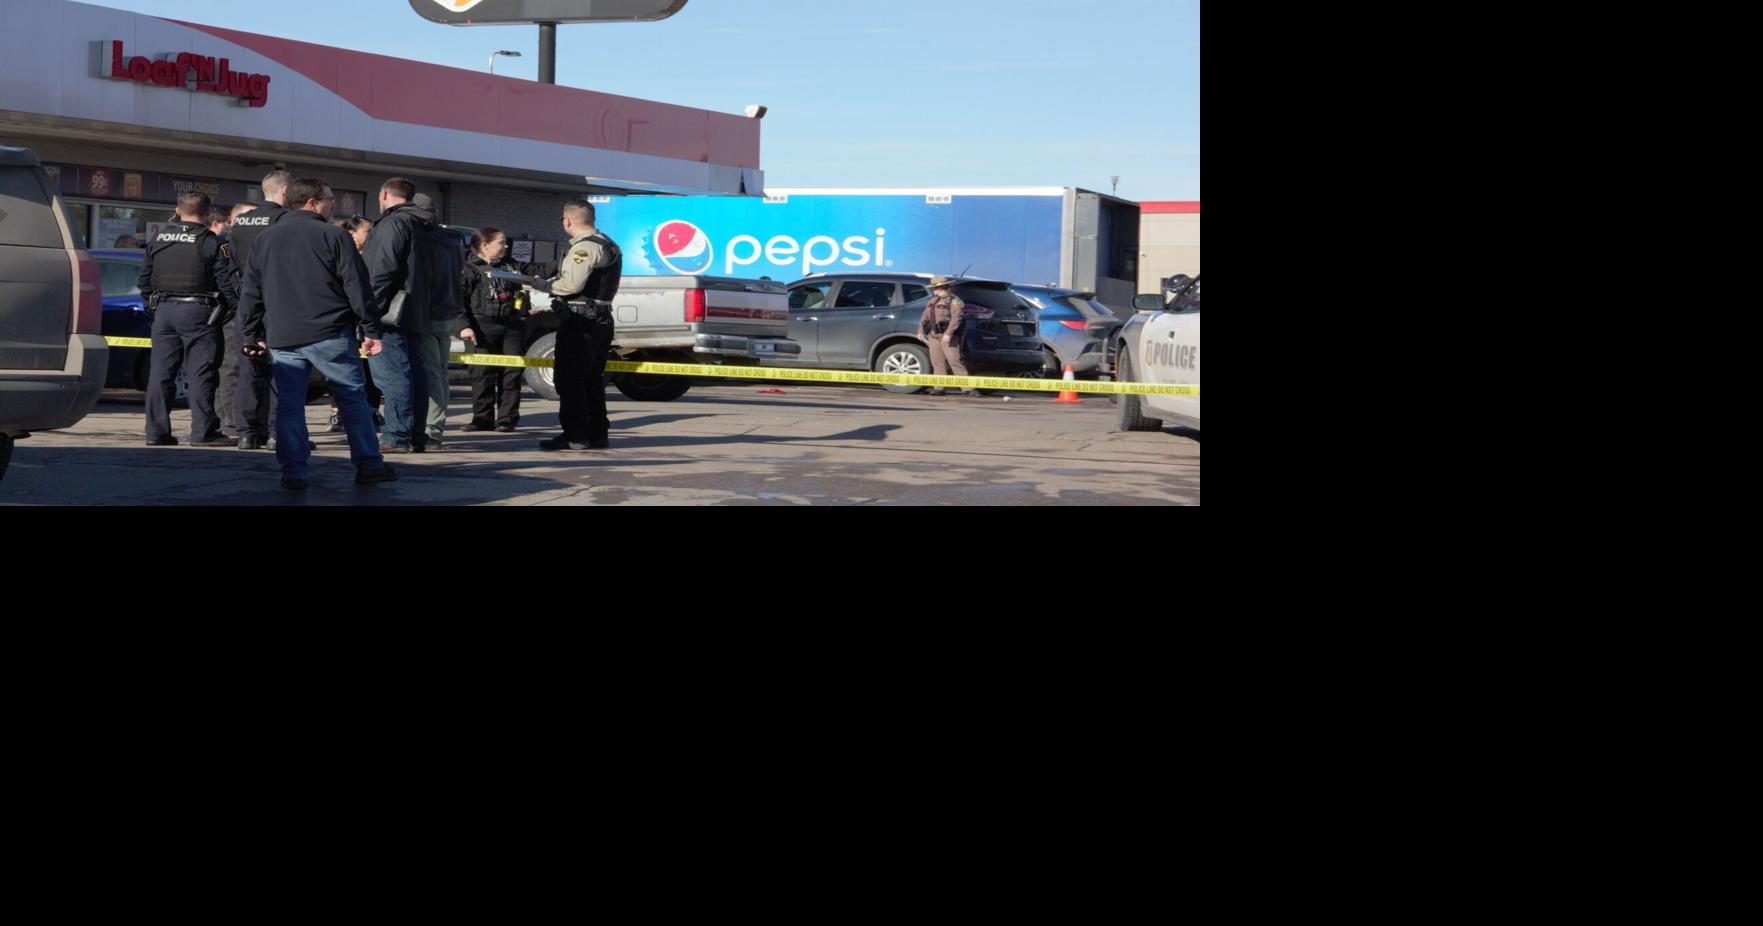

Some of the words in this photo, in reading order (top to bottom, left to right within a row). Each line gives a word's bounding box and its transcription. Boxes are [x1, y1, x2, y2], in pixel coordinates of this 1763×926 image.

[112, 39, 190, 88] Loaf
[216, 58, 270, 107] Jug
[172, 180, 193, 192] YOUR
[231, 216, 270, 226] POLICE
[157, 233, 196, 243] POLICE
[725, 227, 885, 275] pepsi
[1153, 341, 1198, 369] POLICE
